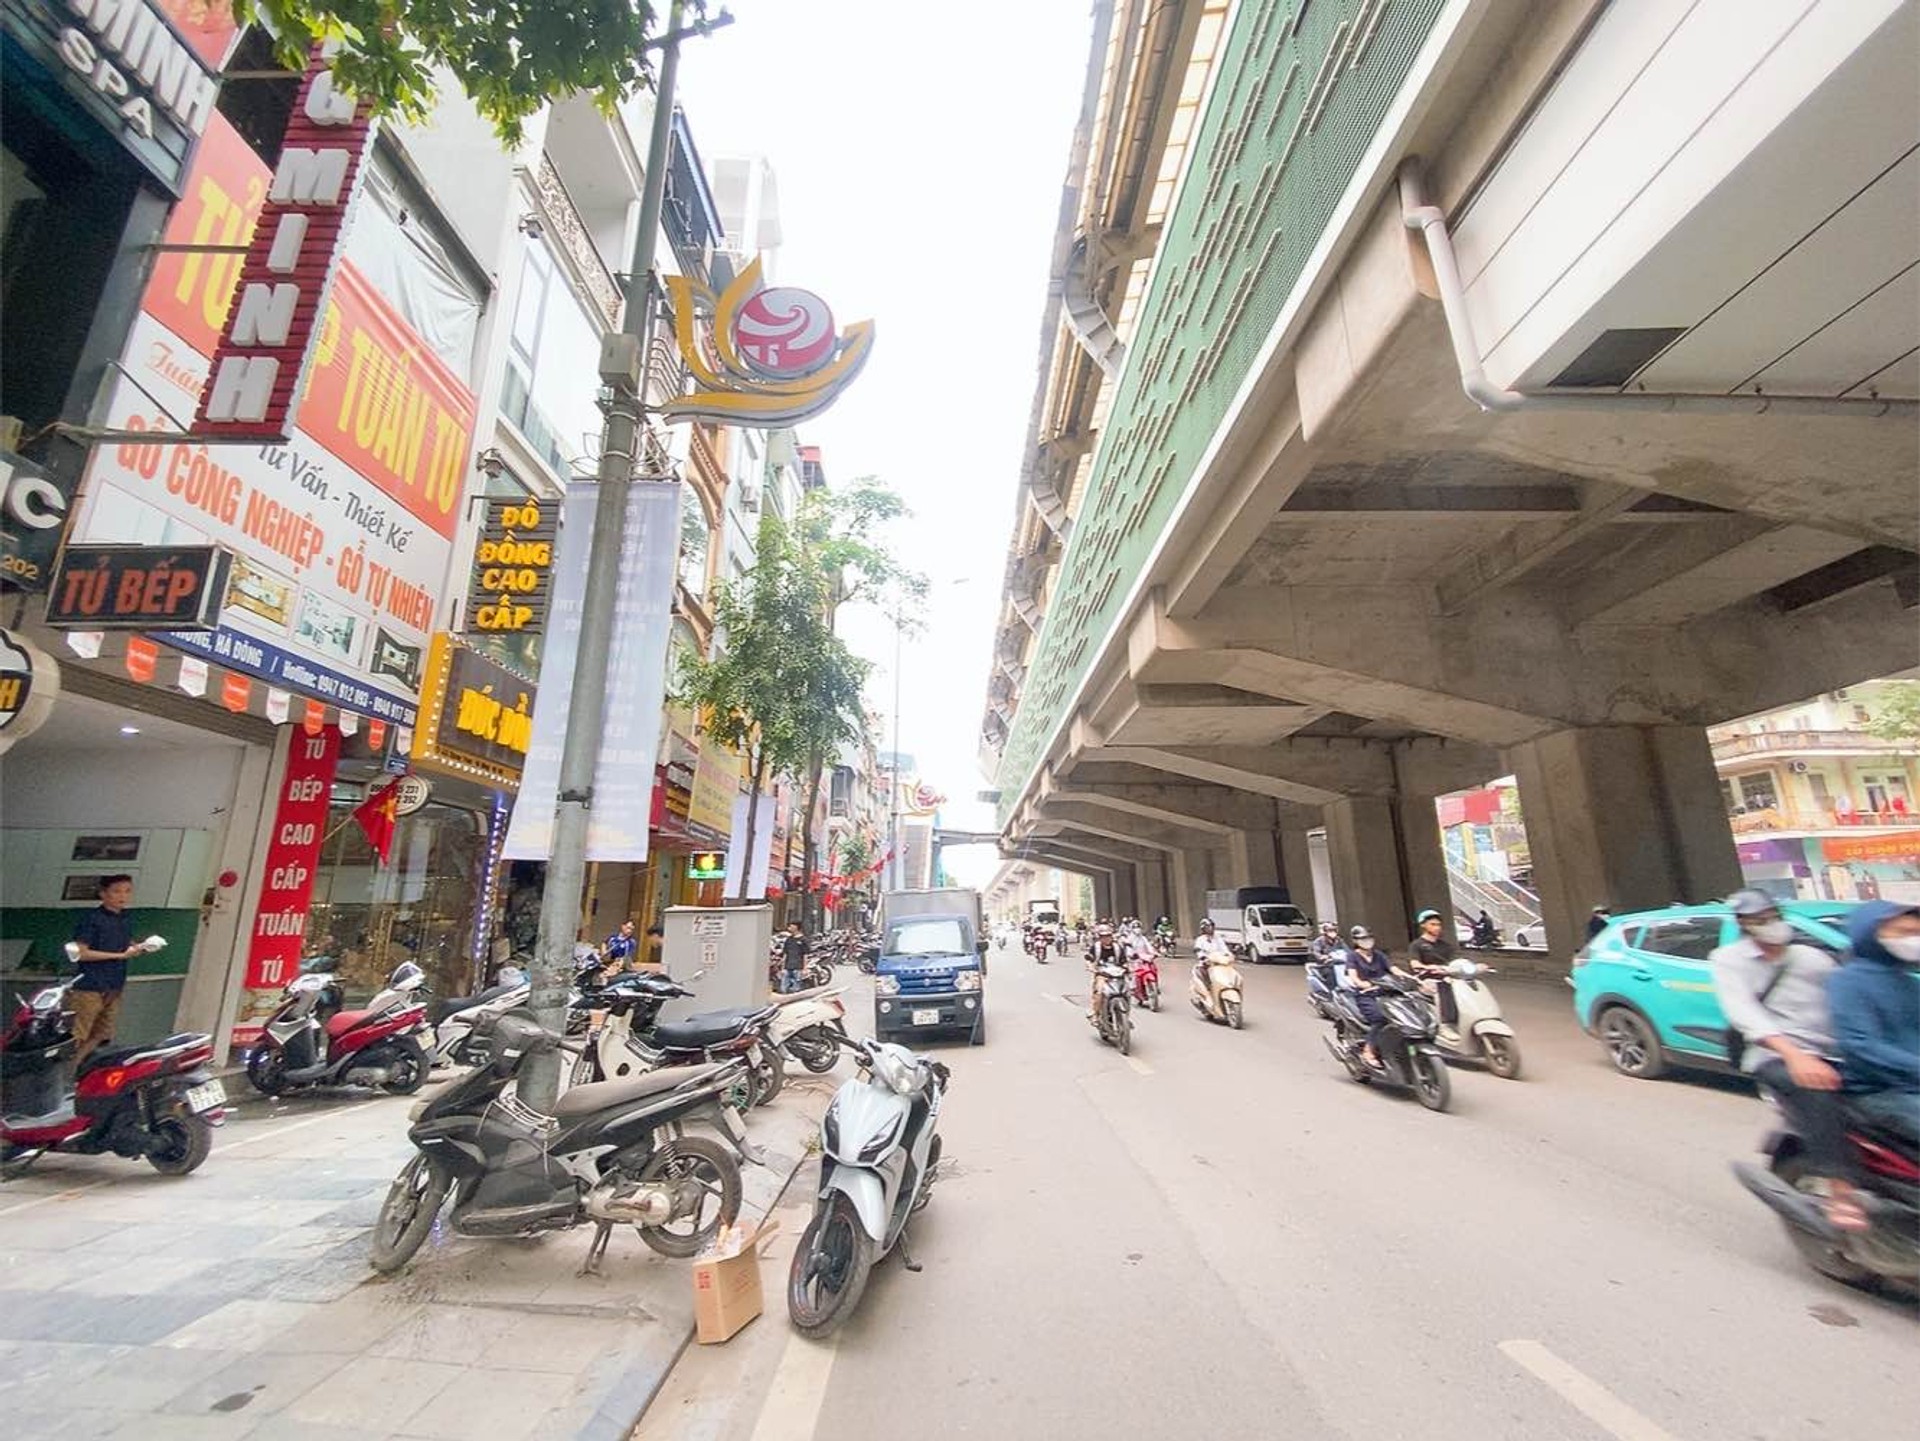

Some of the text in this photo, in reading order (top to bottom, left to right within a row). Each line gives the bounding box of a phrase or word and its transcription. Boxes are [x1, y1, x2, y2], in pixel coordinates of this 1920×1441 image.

[59, 27, 152, 139] SPA
[204, 147, 351, 424] MINH
[289, 451, 328, 500] Vấn
[344, 491, 385, 538] Thiết
[386, 522, 413, 553] Kế
[501, 494, 541, 530] ĐỒ
[166, 443, 243, 528] CÔNG
[242, 487, 325, 575] NGHIỆP
[386, 574, 436, 635] NHIÊN
[478, 529, 553, 567] ĐỒNG
[60, 555, 198, 616] TỦ BẾP
[482, 567, 538, 592] CAO
[476, 593, 533, 630] CẤP
[304, 733, 326, 759] TỦ
[288, 774, 323, 802] BẾP
[279, 823, 316, 846] CAO
[270, 859, 308, 891] CẤP
[257, 903, 305, 937] TUẤN
[260, 954, 284, 984] TÚ
